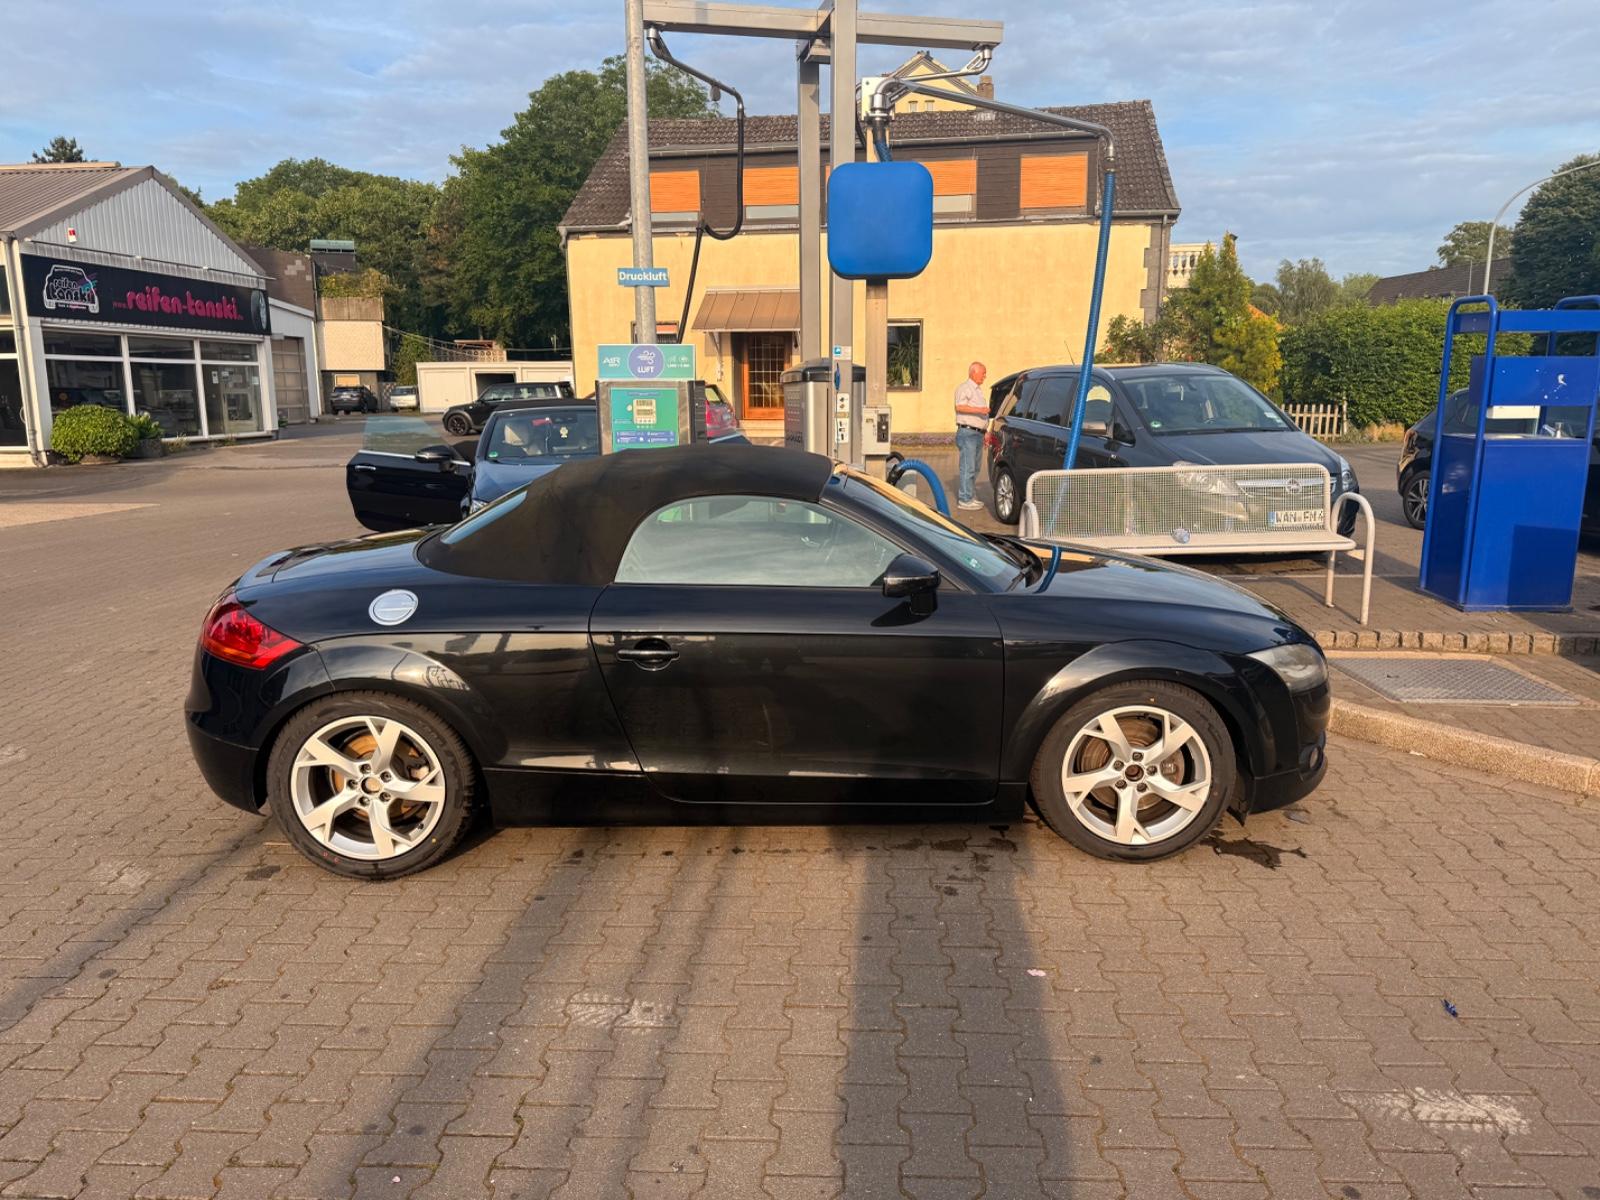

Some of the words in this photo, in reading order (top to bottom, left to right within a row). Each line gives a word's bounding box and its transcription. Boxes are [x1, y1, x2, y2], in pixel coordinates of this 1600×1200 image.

[618, 270, 668, 282] Druckluft
[53, 277, 78, 289] reifen
[49, 282, 94, 304] tanski
